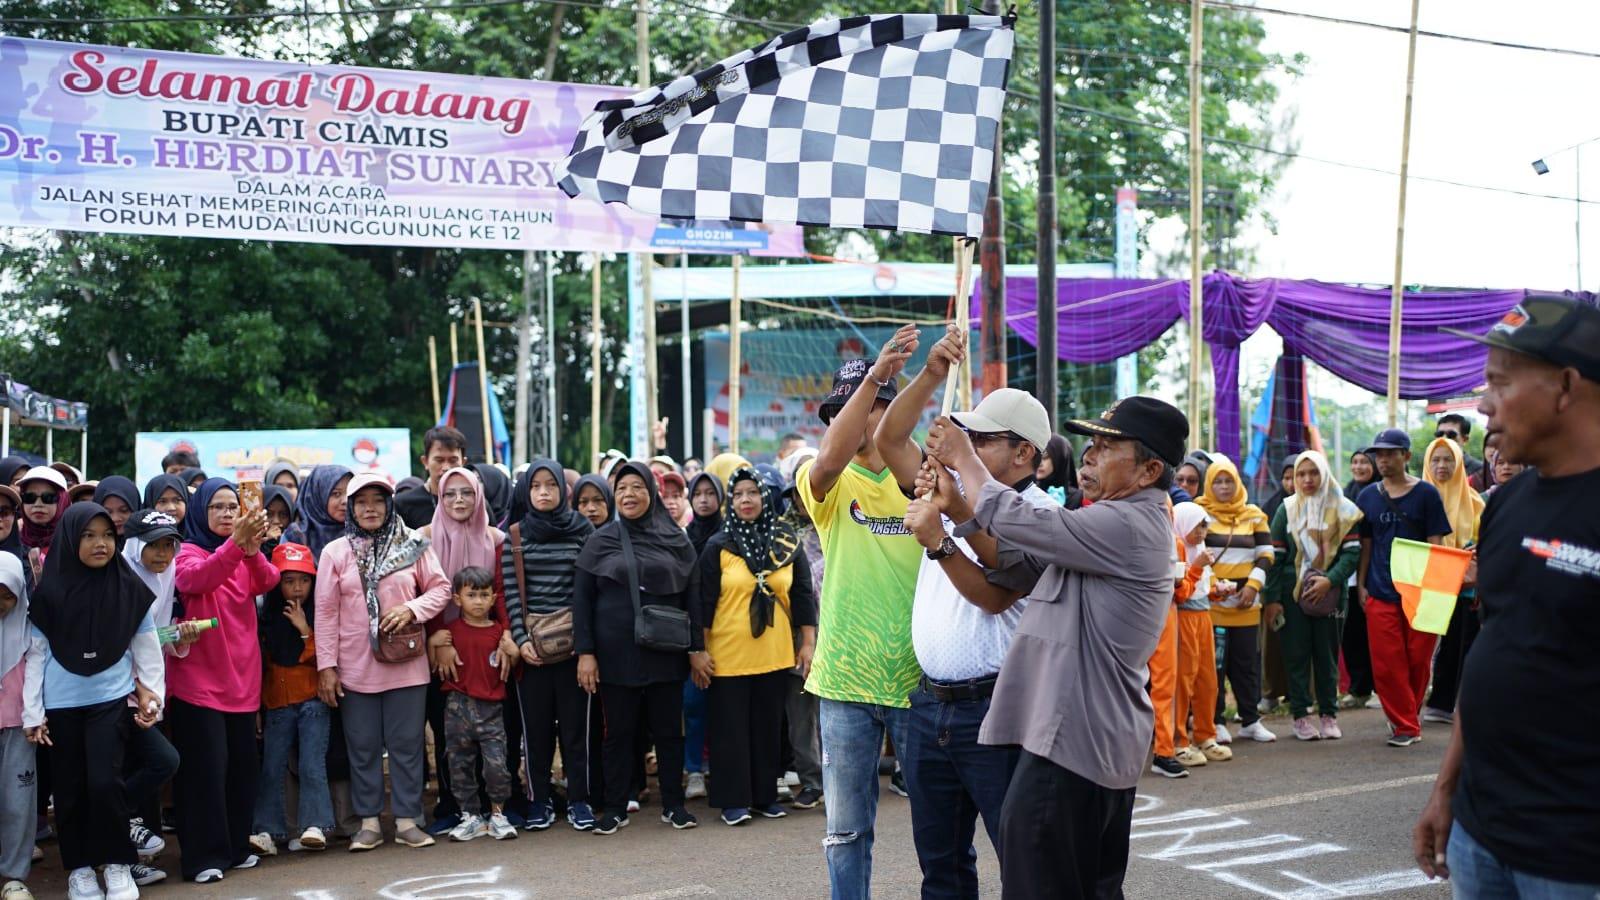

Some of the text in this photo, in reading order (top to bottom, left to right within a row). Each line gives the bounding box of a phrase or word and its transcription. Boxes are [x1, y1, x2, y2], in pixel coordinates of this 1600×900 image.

[63, 50, 531, 134] Selamat Datang
[162, 110, 449, 149] BUPATI CIAMIS
[80, 133, 133, 165] H.
[153, 138, 373, 178] HERDIAT
[40, 186, 553, 224] JALAN SEHAT MEMPERINGATI HARI ULANG TAHUN
[237, 180, 386, 201] DALAM ACARA
[84, 206, 521, 241] FORUM PEMUDA LIUNGGUNUNG KE 12
[685, 229, 734, 240] GHOZIN
